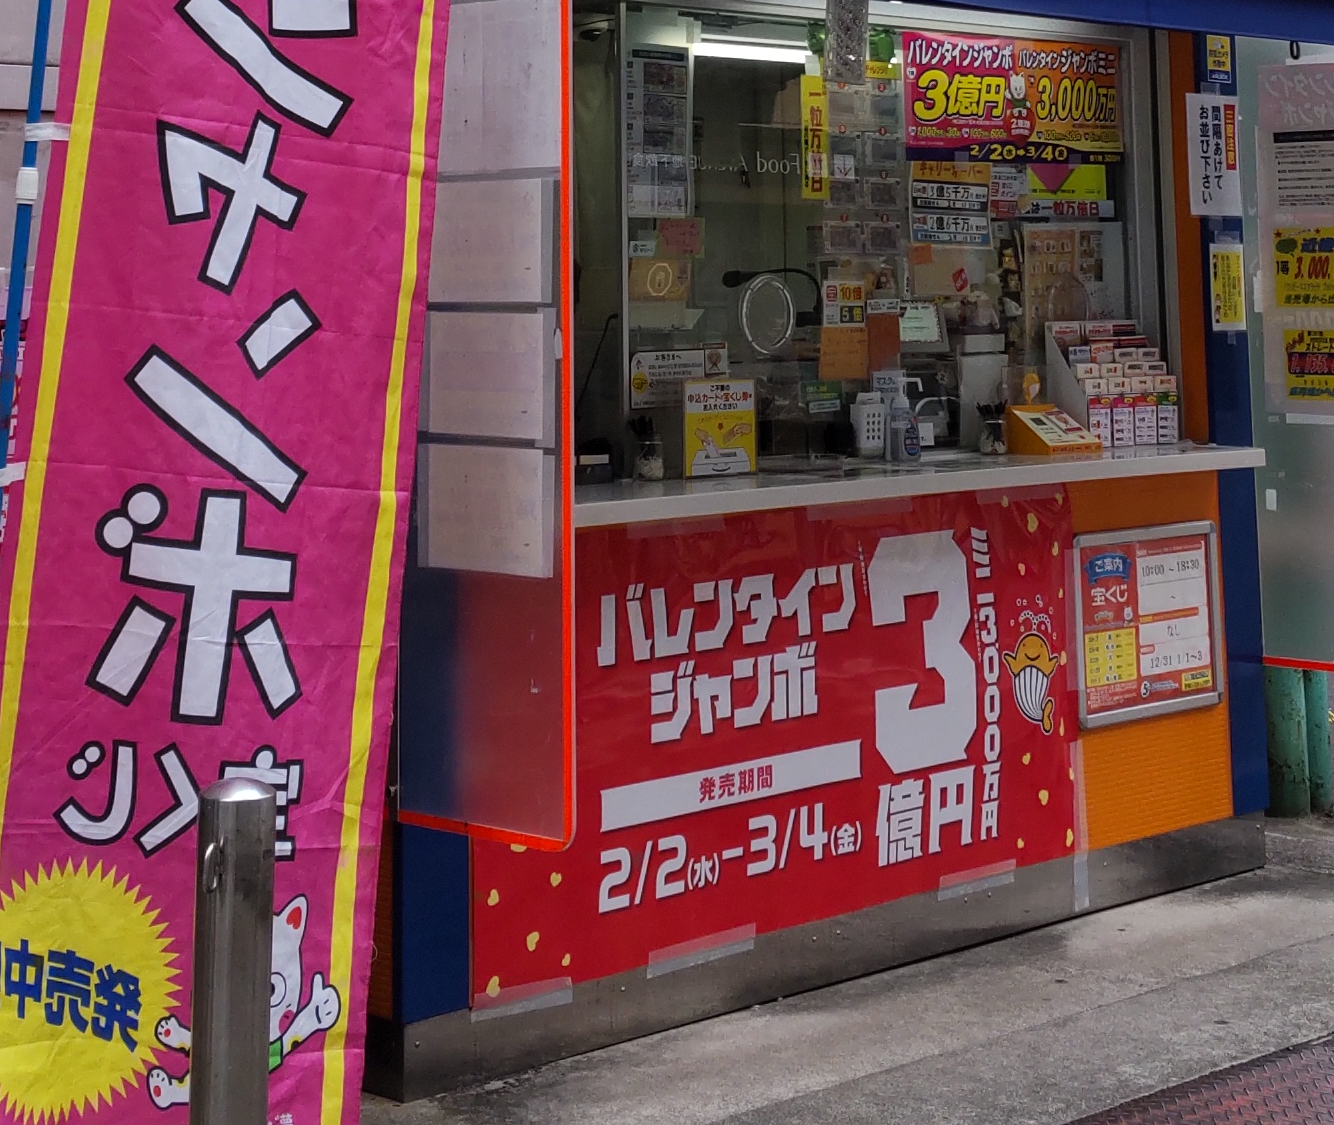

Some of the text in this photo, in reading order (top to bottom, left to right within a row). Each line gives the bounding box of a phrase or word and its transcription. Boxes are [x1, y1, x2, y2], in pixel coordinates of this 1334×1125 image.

[908, 39, 1013, 69] バレンタインジャンボ
[1018, 48, 1116, 74] バレンタインジャンボミニ
[914, 70, 1006, 121] 3億円
[1036, 75, 1116, 122] 3,000万円
[1199, 104, 1212, 205] お並び下さい
[1211, 105, 1223, 190] 間隔あけて
[1095, 557, 1123, 572] ご案内
[597, 563, 857, 667] バレンタイン
[1091, 585, 1128, 607] 宝くじ
[651, 641, 819, 744] ジャンボ
[699, 764, 773, 803] 発売期間
